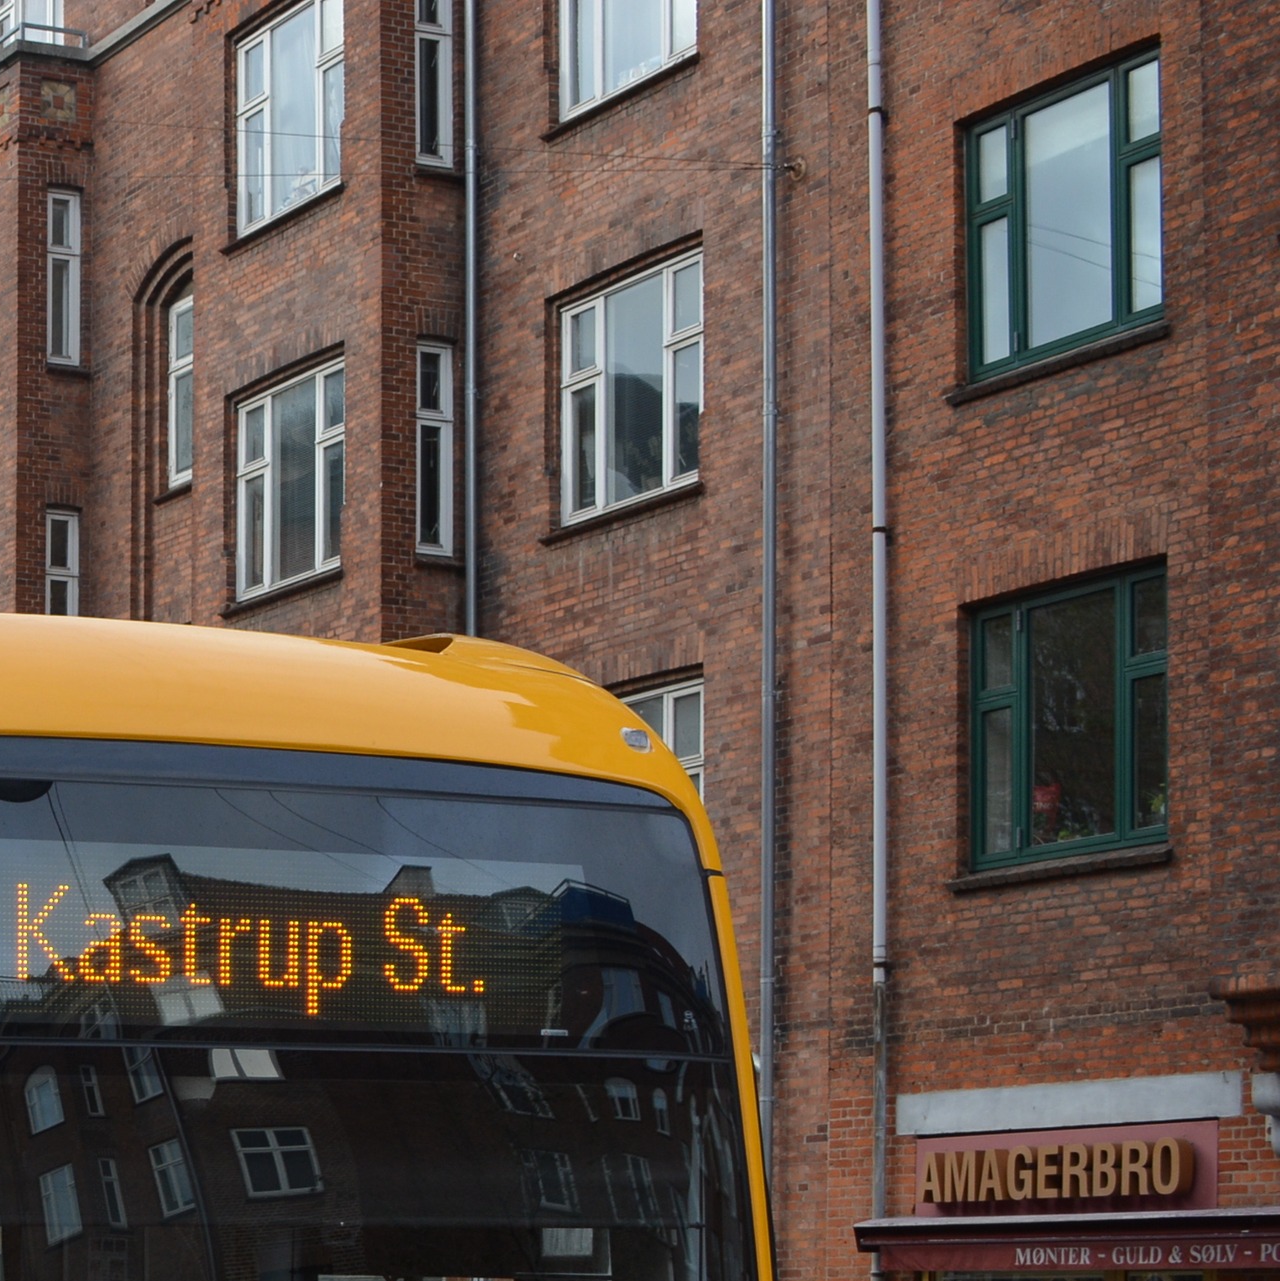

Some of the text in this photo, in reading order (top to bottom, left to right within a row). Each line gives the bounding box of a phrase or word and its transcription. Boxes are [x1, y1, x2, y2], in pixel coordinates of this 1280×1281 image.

[16, 882, 353, 1016] Kastrup
[383, 897, 485, 994] St.
[920, 1137, 1188, 1203] AMAGERBRO
[1015, 1247, 1091, 1266] MØNTER
[1112, 1246, 1163, 1265] GULD
[1168, 1245, 1183, 1264] &
[1190, 1244, 1238, 1264] SØLV
